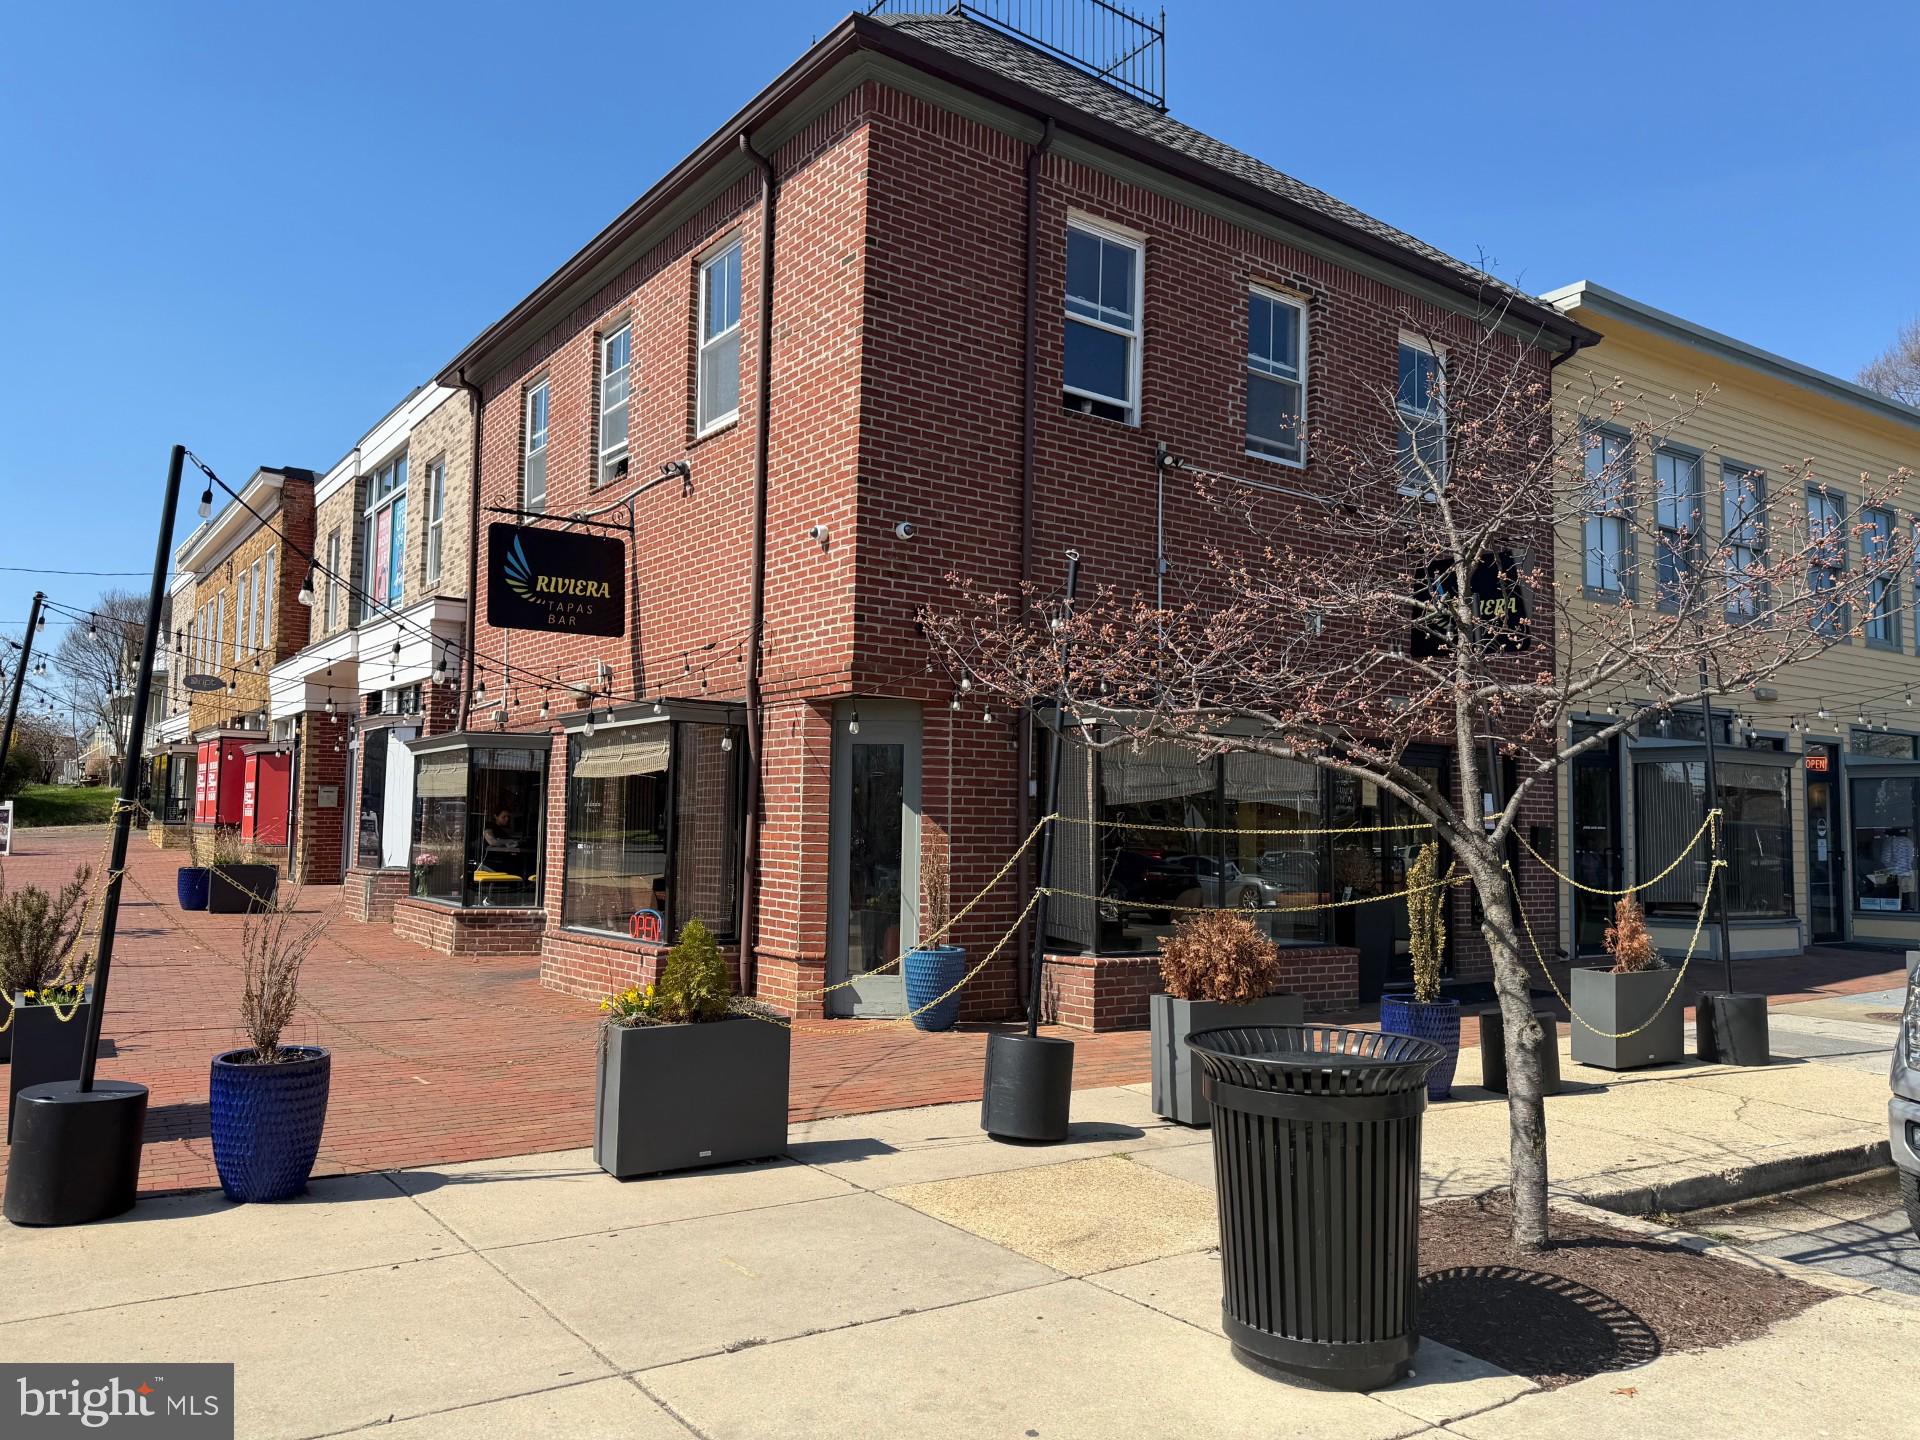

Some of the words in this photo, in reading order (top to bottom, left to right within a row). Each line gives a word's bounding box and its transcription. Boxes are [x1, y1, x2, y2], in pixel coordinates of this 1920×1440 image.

[536, 575, 611, 599] RIVIERA
[548, 601, 593, 615] TAPAS
[548, 614, 577, 626] BAR
[1805, 759, 1825, 770] OPEN
[629, 913, 661, 942] OPEN
